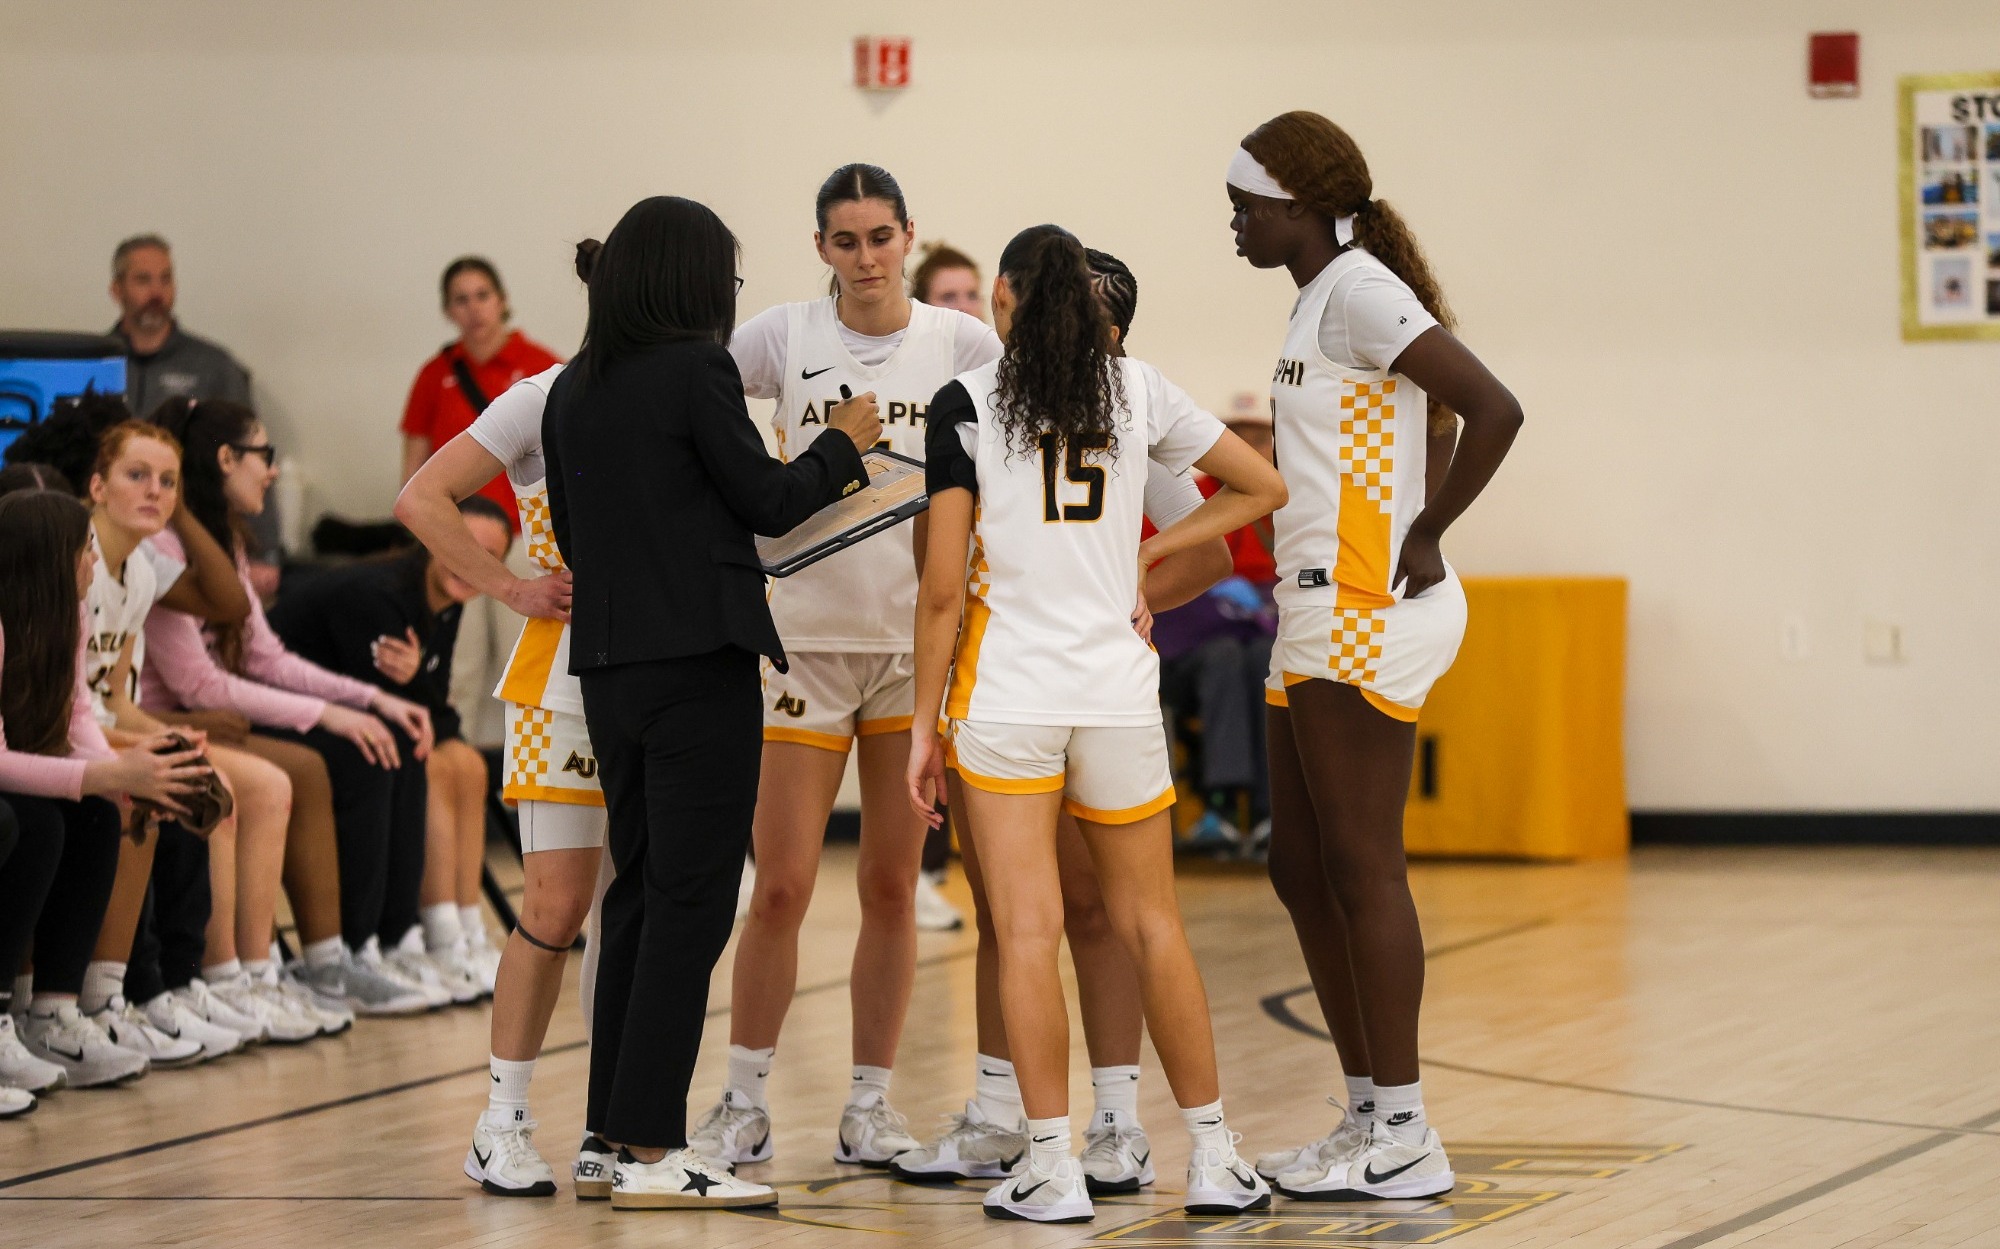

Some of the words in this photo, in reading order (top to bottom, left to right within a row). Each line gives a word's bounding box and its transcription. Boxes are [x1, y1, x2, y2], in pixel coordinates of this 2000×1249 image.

[1037, 430, 1111, 523] 15
[773, 690, 806, 718] AU
[561, 750, 596, 779] AU
